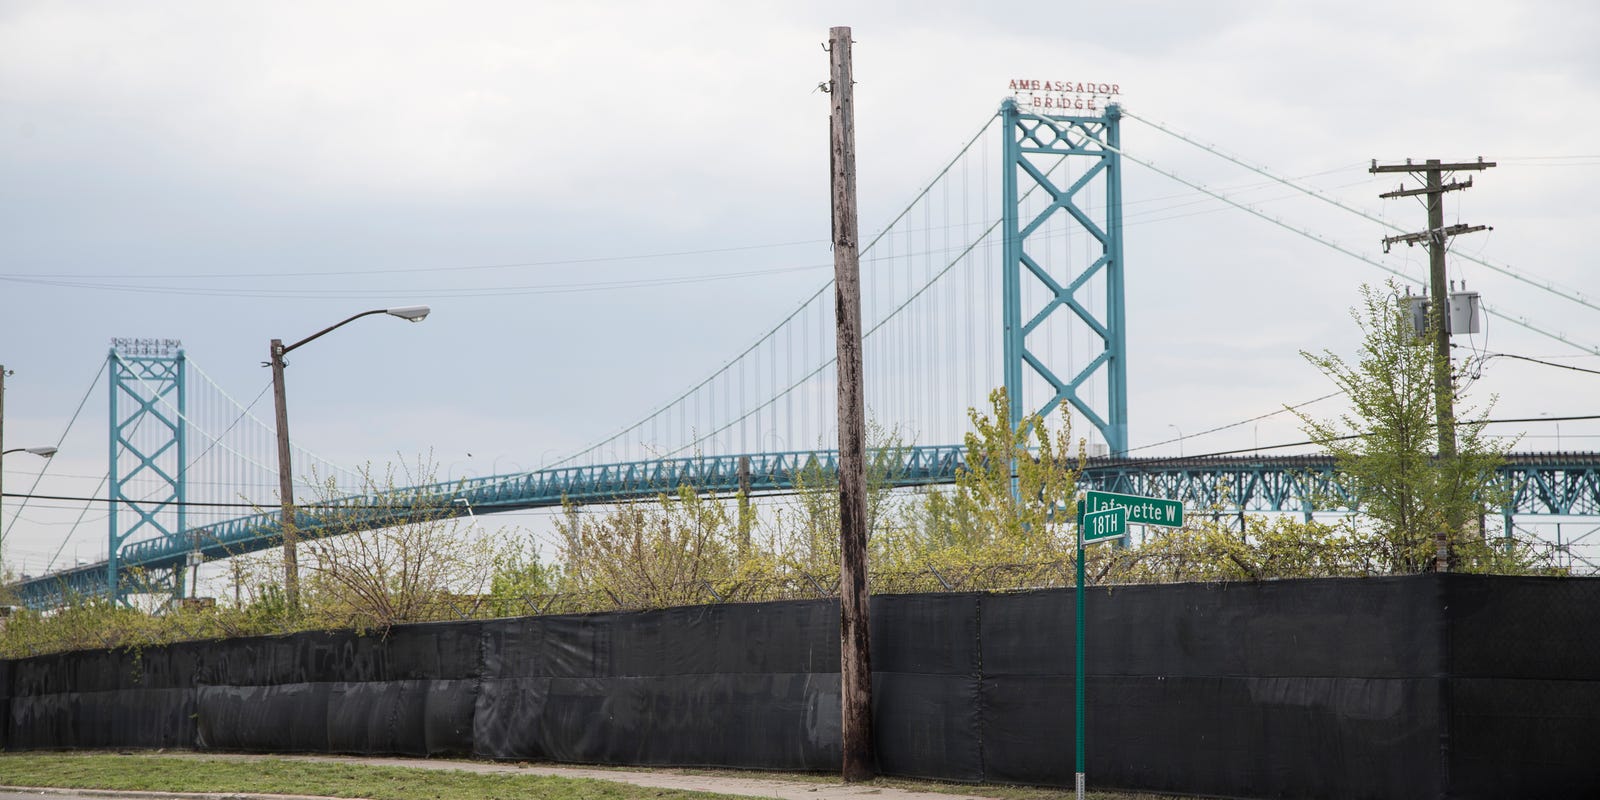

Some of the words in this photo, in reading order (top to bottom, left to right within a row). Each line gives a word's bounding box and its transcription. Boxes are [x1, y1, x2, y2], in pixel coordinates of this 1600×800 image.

[1009, 79, 1120, 95] AMBASSADOR
[1033, 97, 1095, 110] BRIDGE
[1165, 504, 1176, 522] W
[1092, 513, 1118, 535] 18TH
